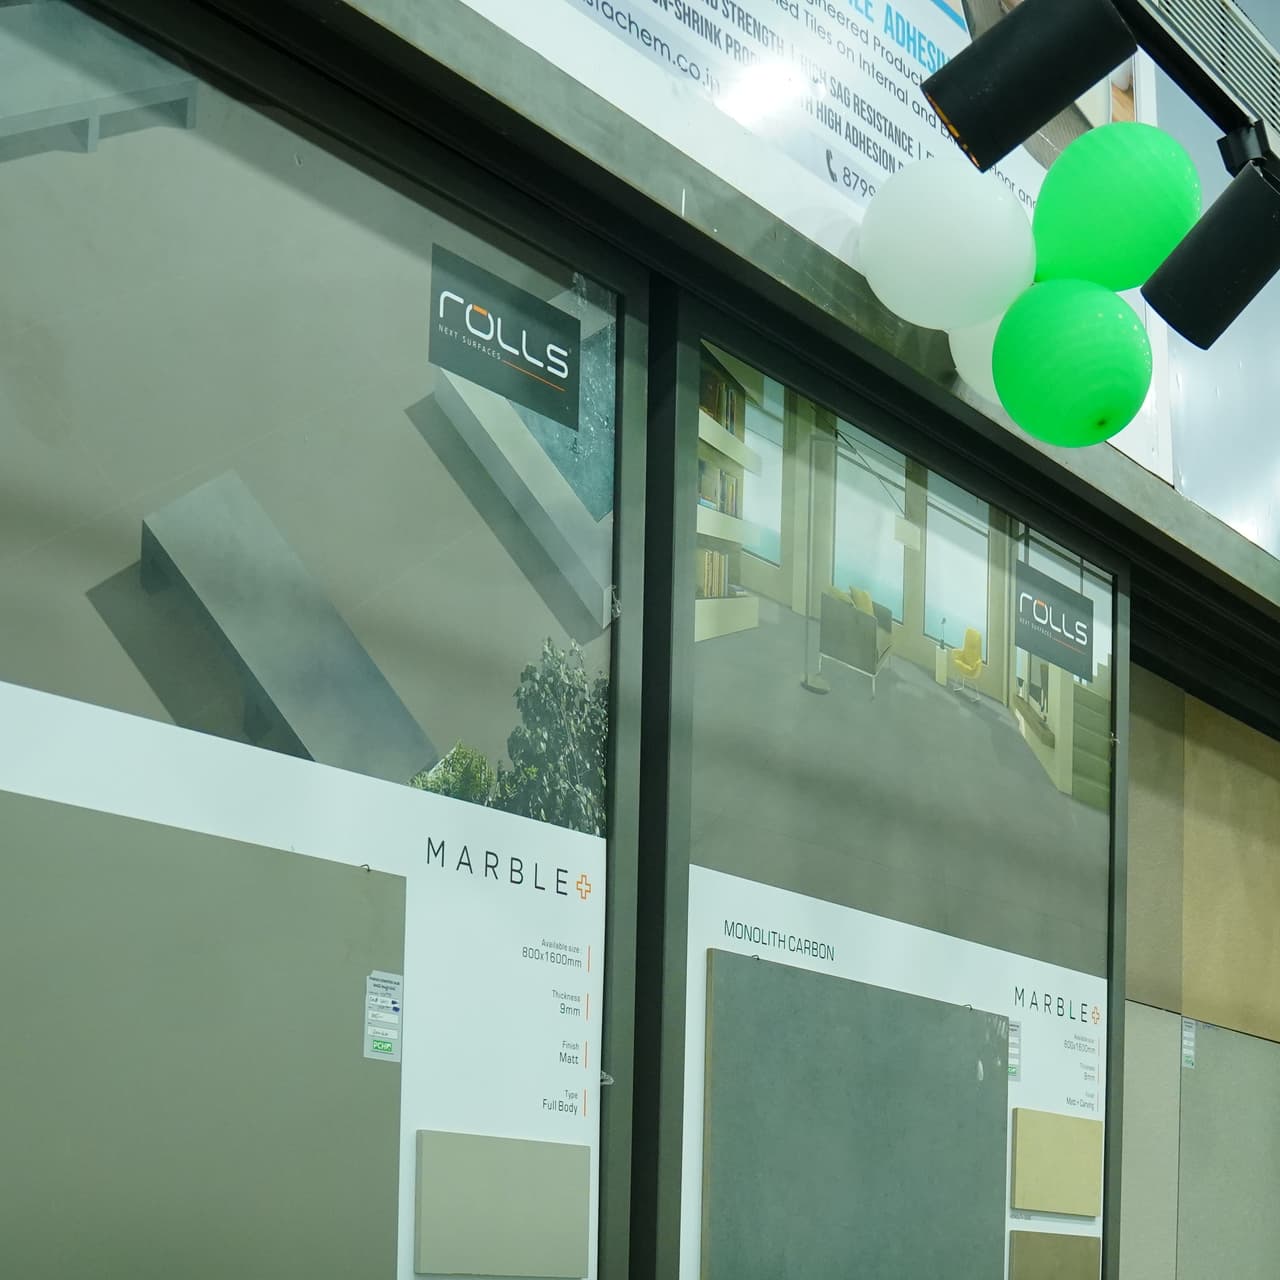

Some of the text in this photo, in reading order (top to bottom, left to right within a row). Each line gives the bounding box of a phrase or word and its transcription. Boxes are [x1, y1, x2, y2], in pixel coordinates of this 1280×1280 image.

[722, 0, 785, 57] STRENGTH
[829, 75, 851, 108] SAG
[853, 92, 914, 159] RESISTANCE
[803, 9, 833, 45] Tiles
[836, 40, 855, 63] on
[859, 53, 908, 105] Internal
[912, 97, 937, 129] and
[816, 100, 842, 137] HIGH
[844, 117, 896, 174] ADHESION
[438, 323, 502, 361] NEXT SURFACES
[426, 836, 569, 896] MARBLE
[522, 946, 582, 969] 800x1600mm
[723, 919, 835, 961] MONOLITH CARBON
[559, 1002, 581, 1017] 9mm
[1014, 985, 1088, 1023] MARBLE
[559, 1051, 580, 1066] Matt
[542, 1098, 578, 1116] Full Body
